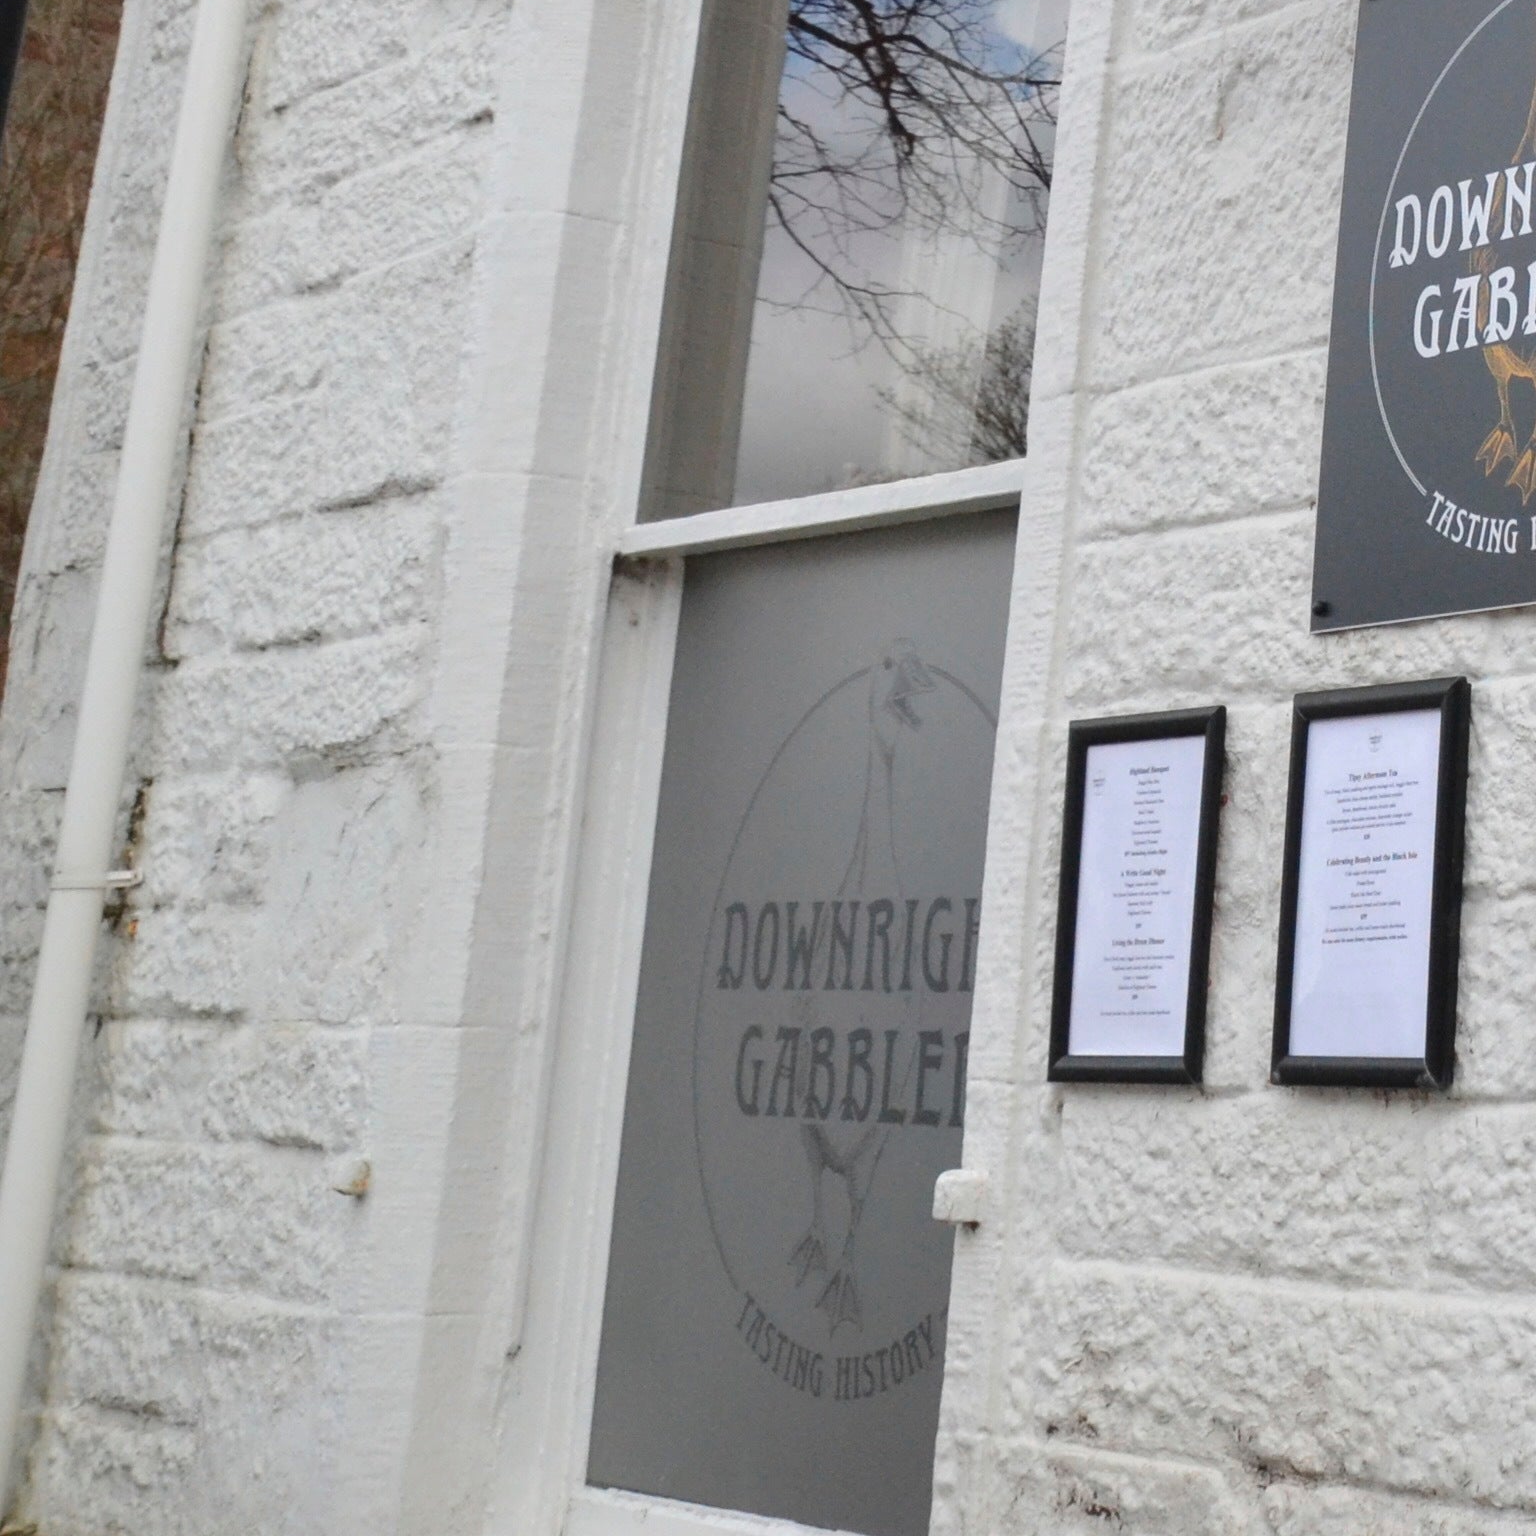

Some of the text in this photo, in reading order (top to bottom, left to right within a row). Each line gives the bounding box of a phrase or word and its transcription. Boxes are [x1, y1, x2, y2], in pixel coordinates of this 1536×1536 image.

[1426, 491, 1518, 554] TASTING
[736, 1291, 936, 1400] TASTING HISTORY
